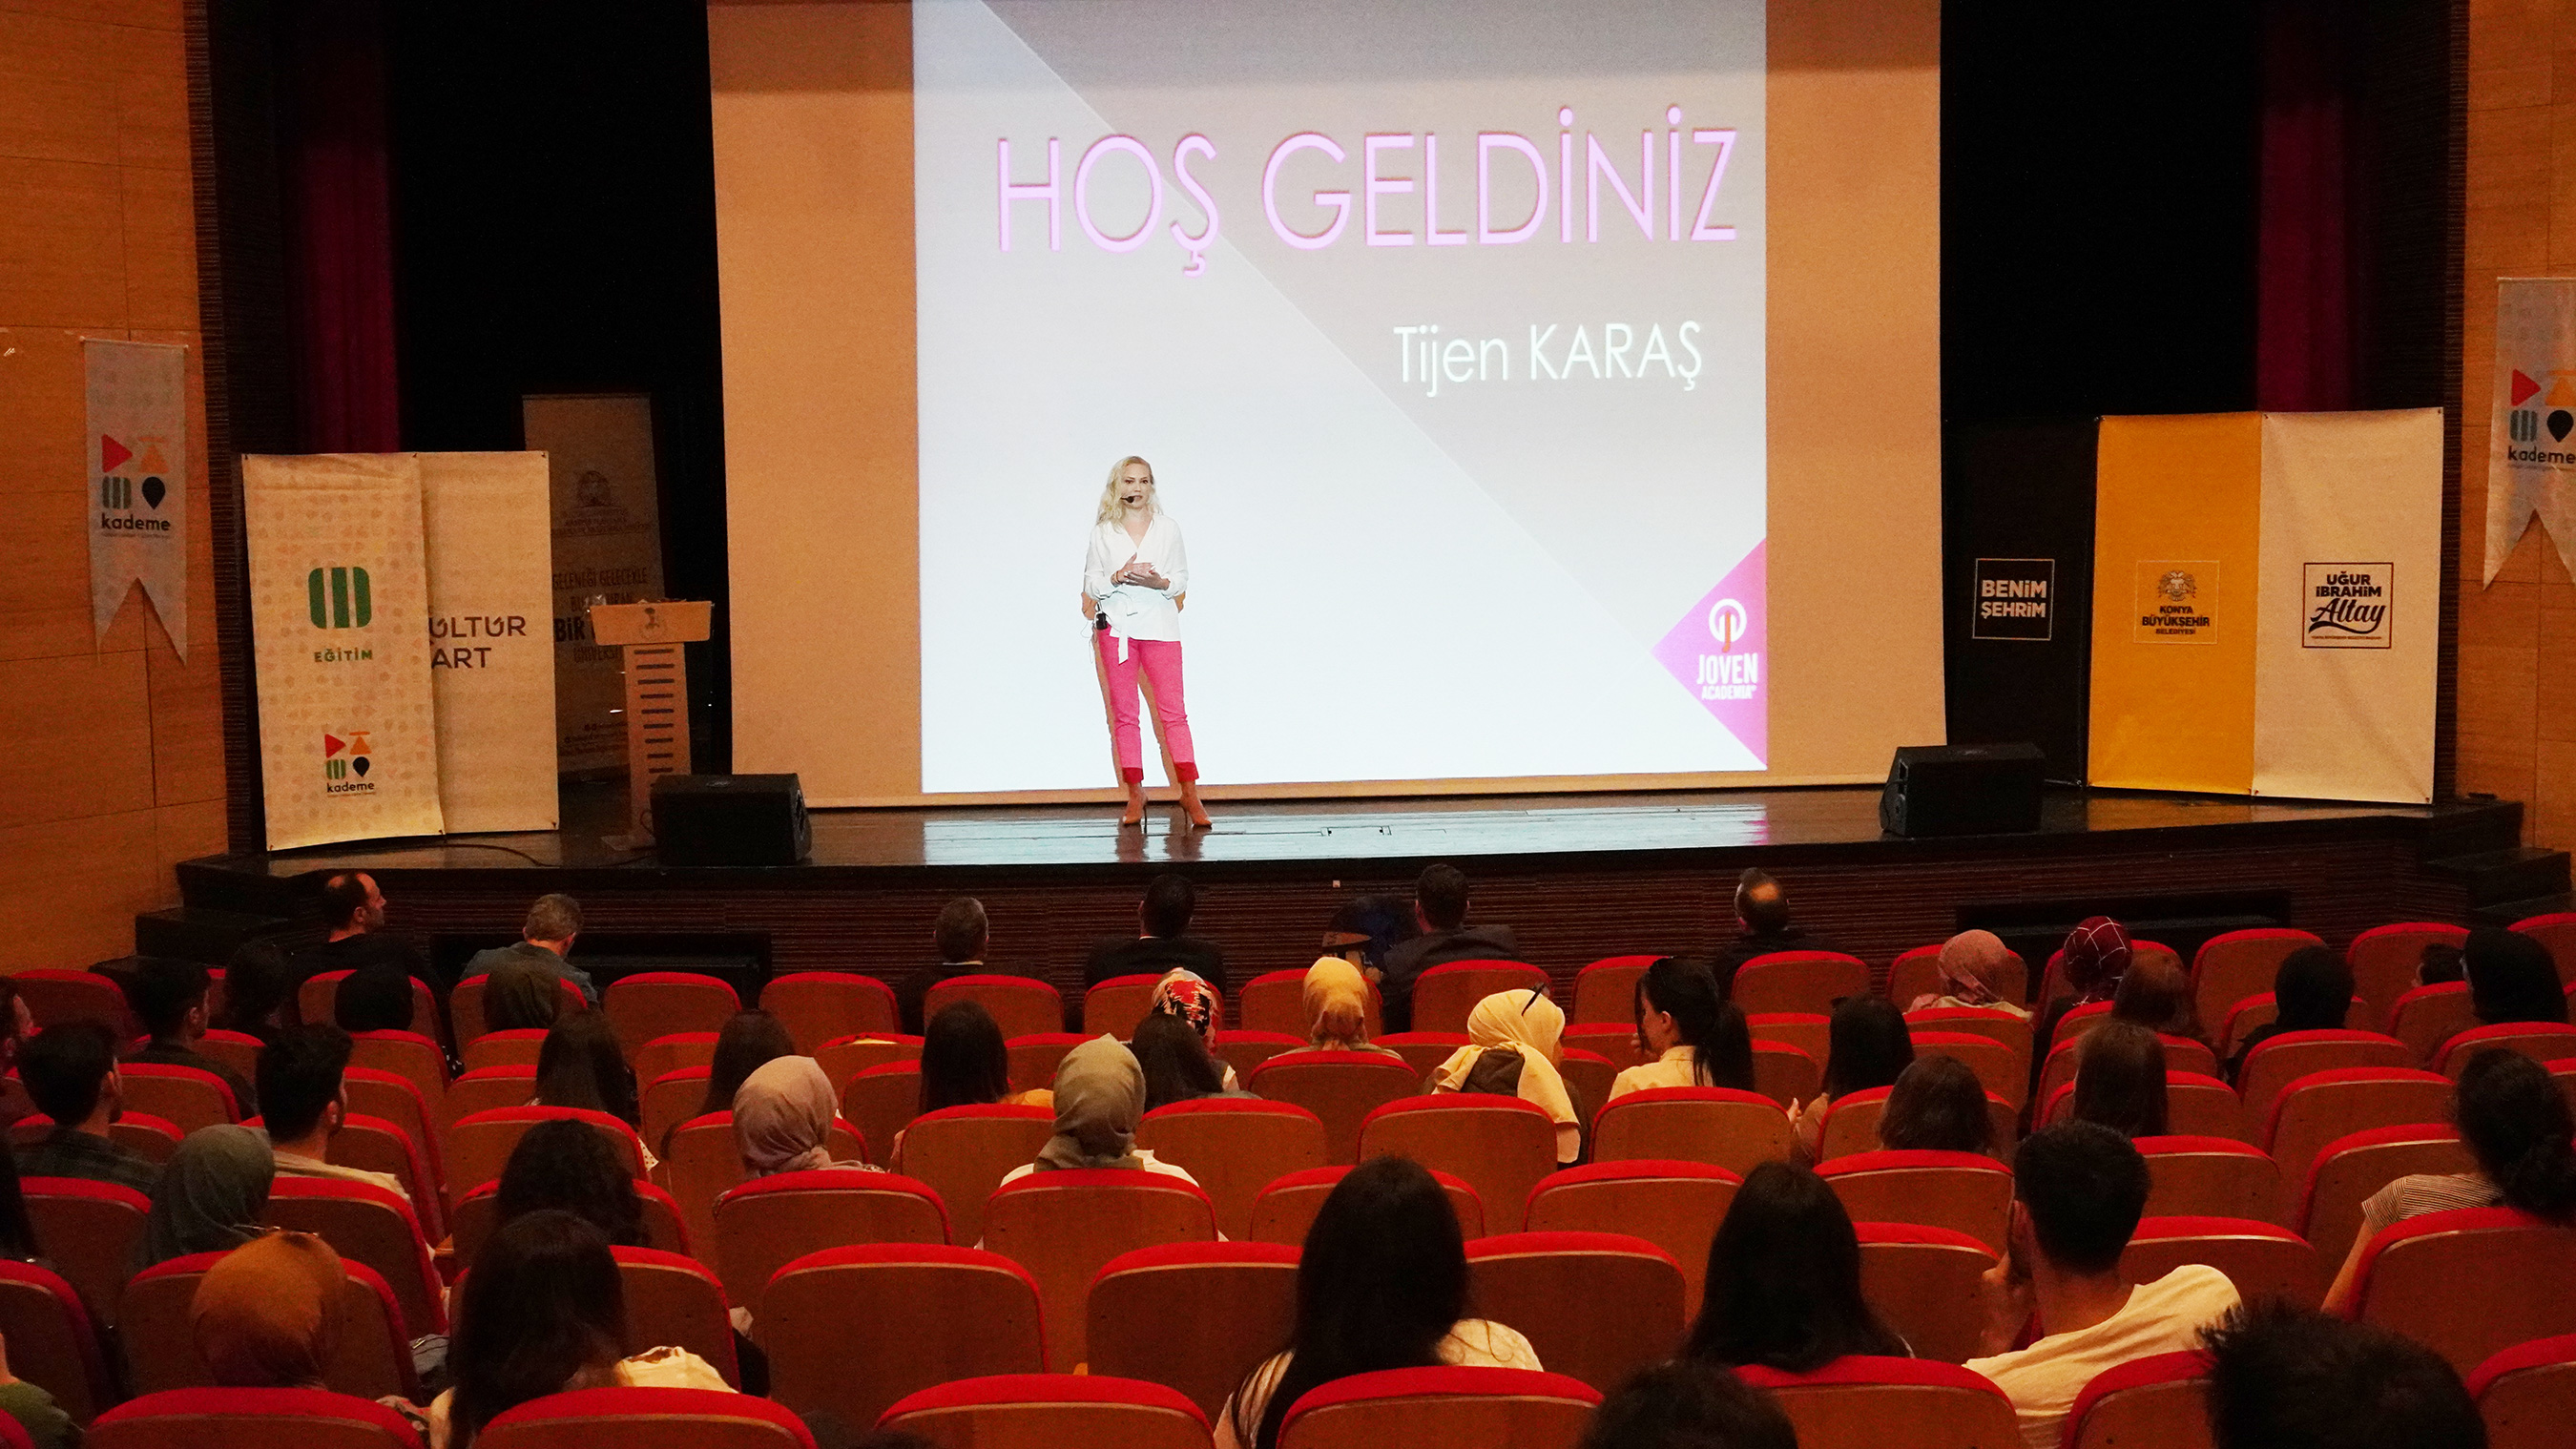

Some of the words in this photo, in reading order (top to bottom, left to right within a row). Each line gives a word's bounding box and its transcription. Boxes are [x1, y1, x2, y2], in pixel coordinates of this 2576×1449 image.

[997, 133, 1219, 278] HOŞ
[1262, 105, 1738, 252] GELDİNİZ
[1393, 323, 1509, 398] Tijen
[1529, 321, 1704, 391] KARAŞ
[2507, 445, 2576, 465] kademe
[100, 511, 171, 531] kademe
[2326, 570, 2372, 586] UĞUR
[1982, 579, 2047, 598] BENİM
[2316, 586, 2382, 597] İBRAHİM
[1981, 601, 2046, 619] ŞEHRİM
[2159, 605, 2194, 614] KONYA
[2308, 597, 2387, 634] Altay
[2142, 614, 2211, 628] BÜYÜKŞEHİR
[314, 647, 373, 663] EĞİTİM
[429, 647, 492, 670] ART
[1696, 652, 1758, 685] JOVEN
[326, 780, 375, 794] kademe
